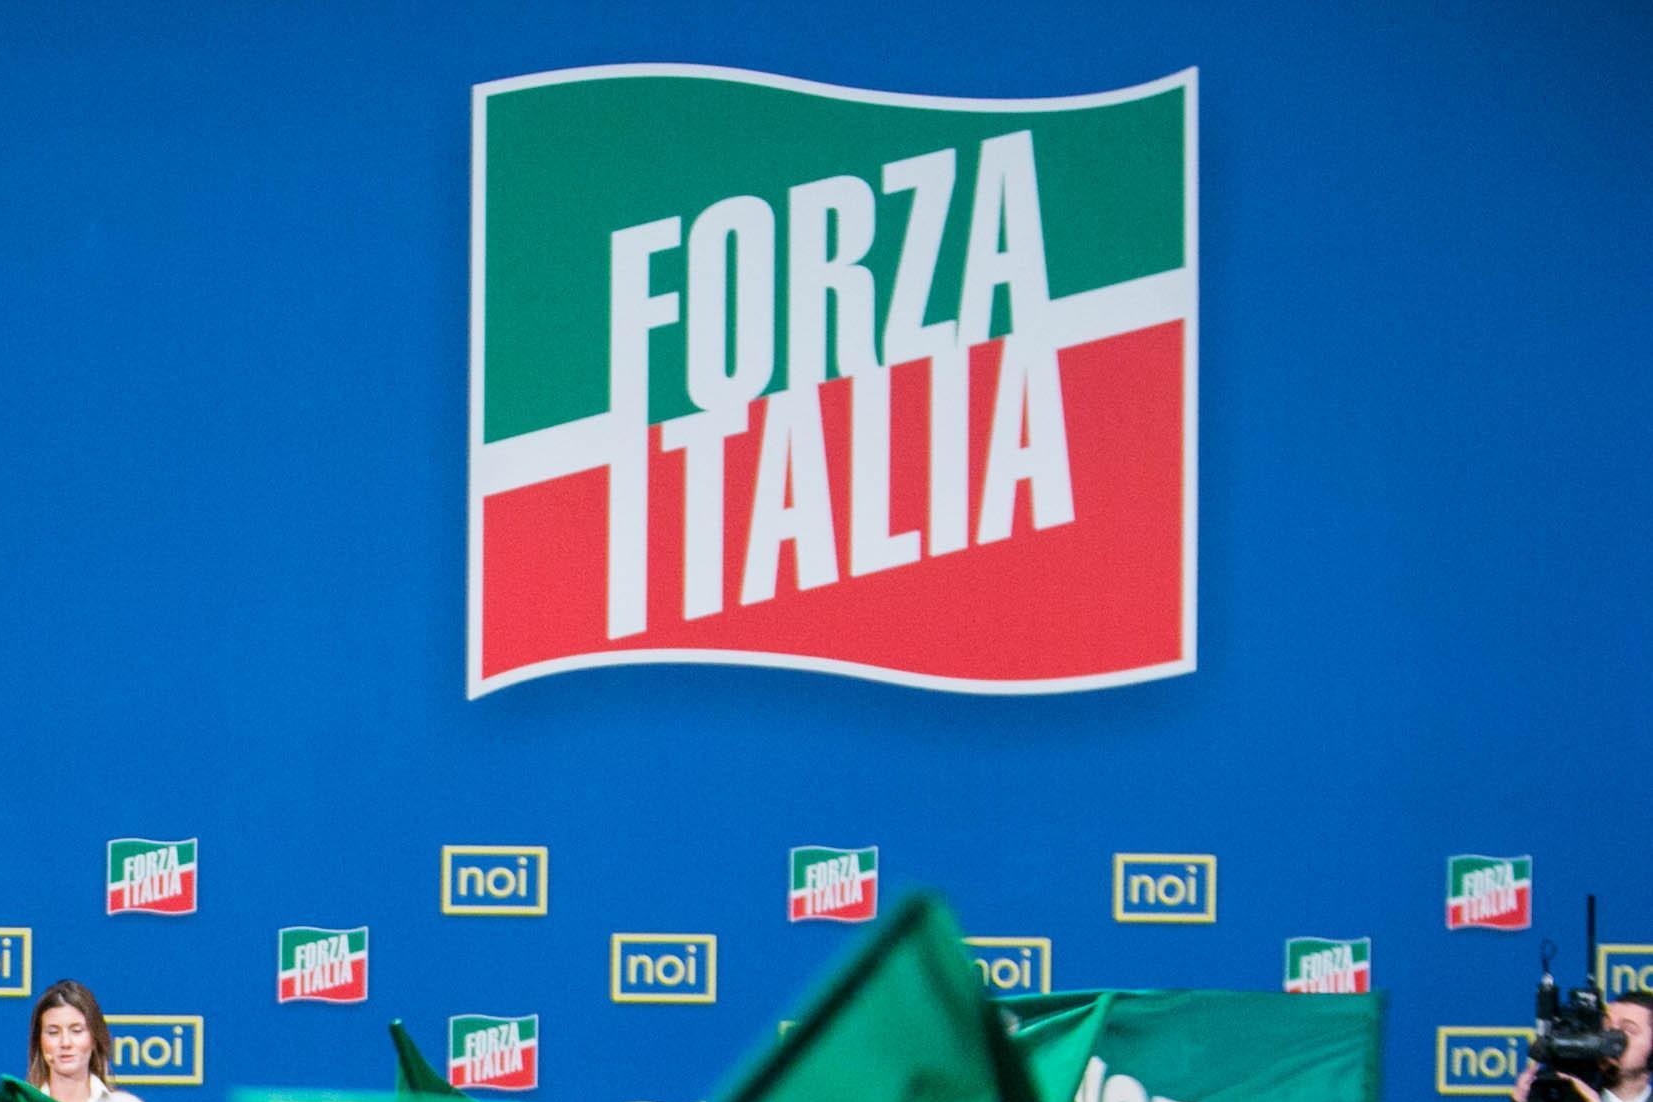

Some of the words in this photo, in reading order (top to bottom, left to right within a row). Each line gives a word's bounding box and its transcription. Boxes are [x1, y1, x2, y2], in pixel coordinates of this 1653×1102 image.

[609, 129, 1050, 412] FORZA
[607, 332, 1076, 641] ITALIA
[123, 846, 178, 882] FORZA
[457, 856, 528, 898] noi
[805, 854, 860, 890] FORZA
[122, 871, 182, 908] ITALIA
[805, 878, 864, 915] ITALIA
[1129, 865, 1198, 905] noi
[295, 934, 350, 971] FORZA
[627, 944, 696, 986] noi
[294, 961, 353, 998] ITALIA
[1612, 965, 1653, 993] no
[112, 1025, 183, 1067] noi
[465, 1022, 519, 1058] FORZA
[1451, 1037, 1518, 1077] noi
[464, 1047, 524, 1083] ITALIA
